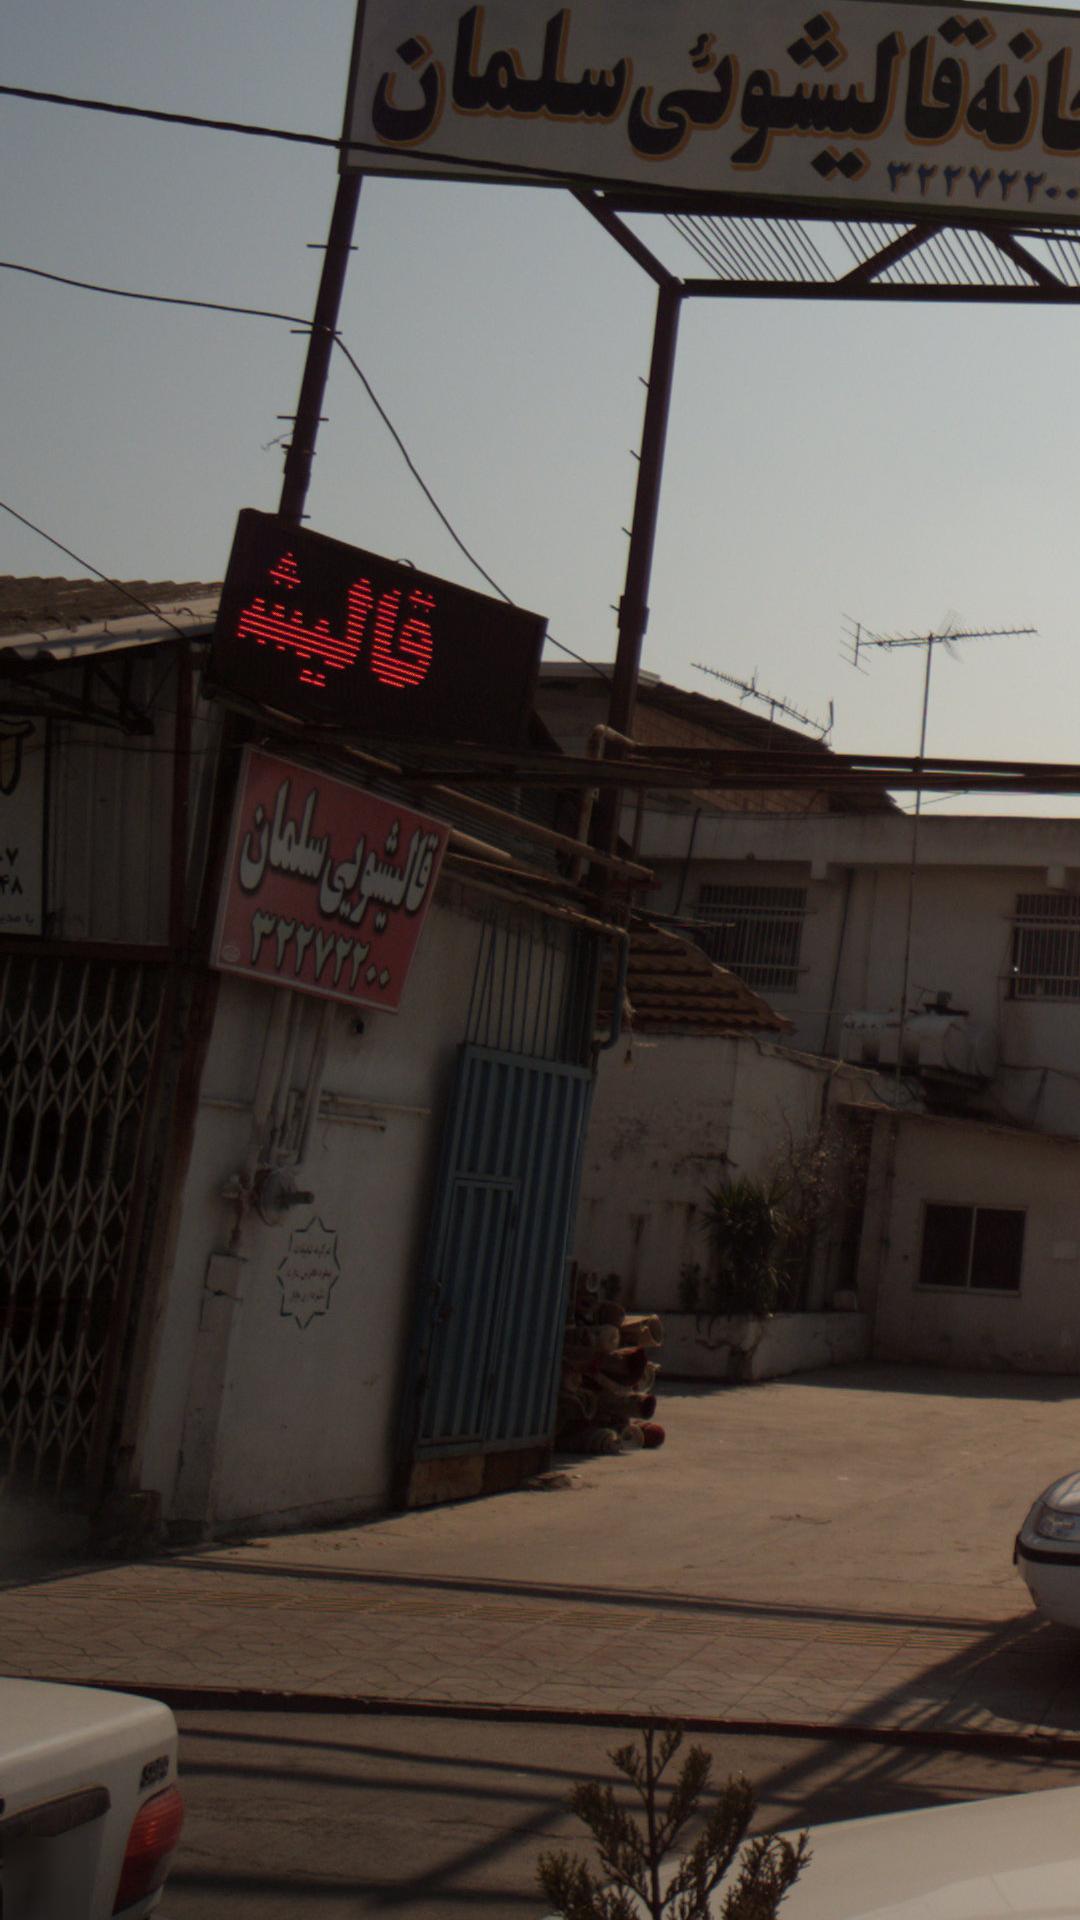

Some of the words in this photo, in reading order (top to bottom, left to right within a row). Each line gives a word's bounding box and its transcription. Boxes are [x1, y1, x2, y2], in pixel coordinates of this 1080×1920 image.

[373, 5, 632, 146] سلمان
[239, 778, 329, 893] سلمان
[251, 908, 391, 991] ۳۲۲۷۲۲۰۰
